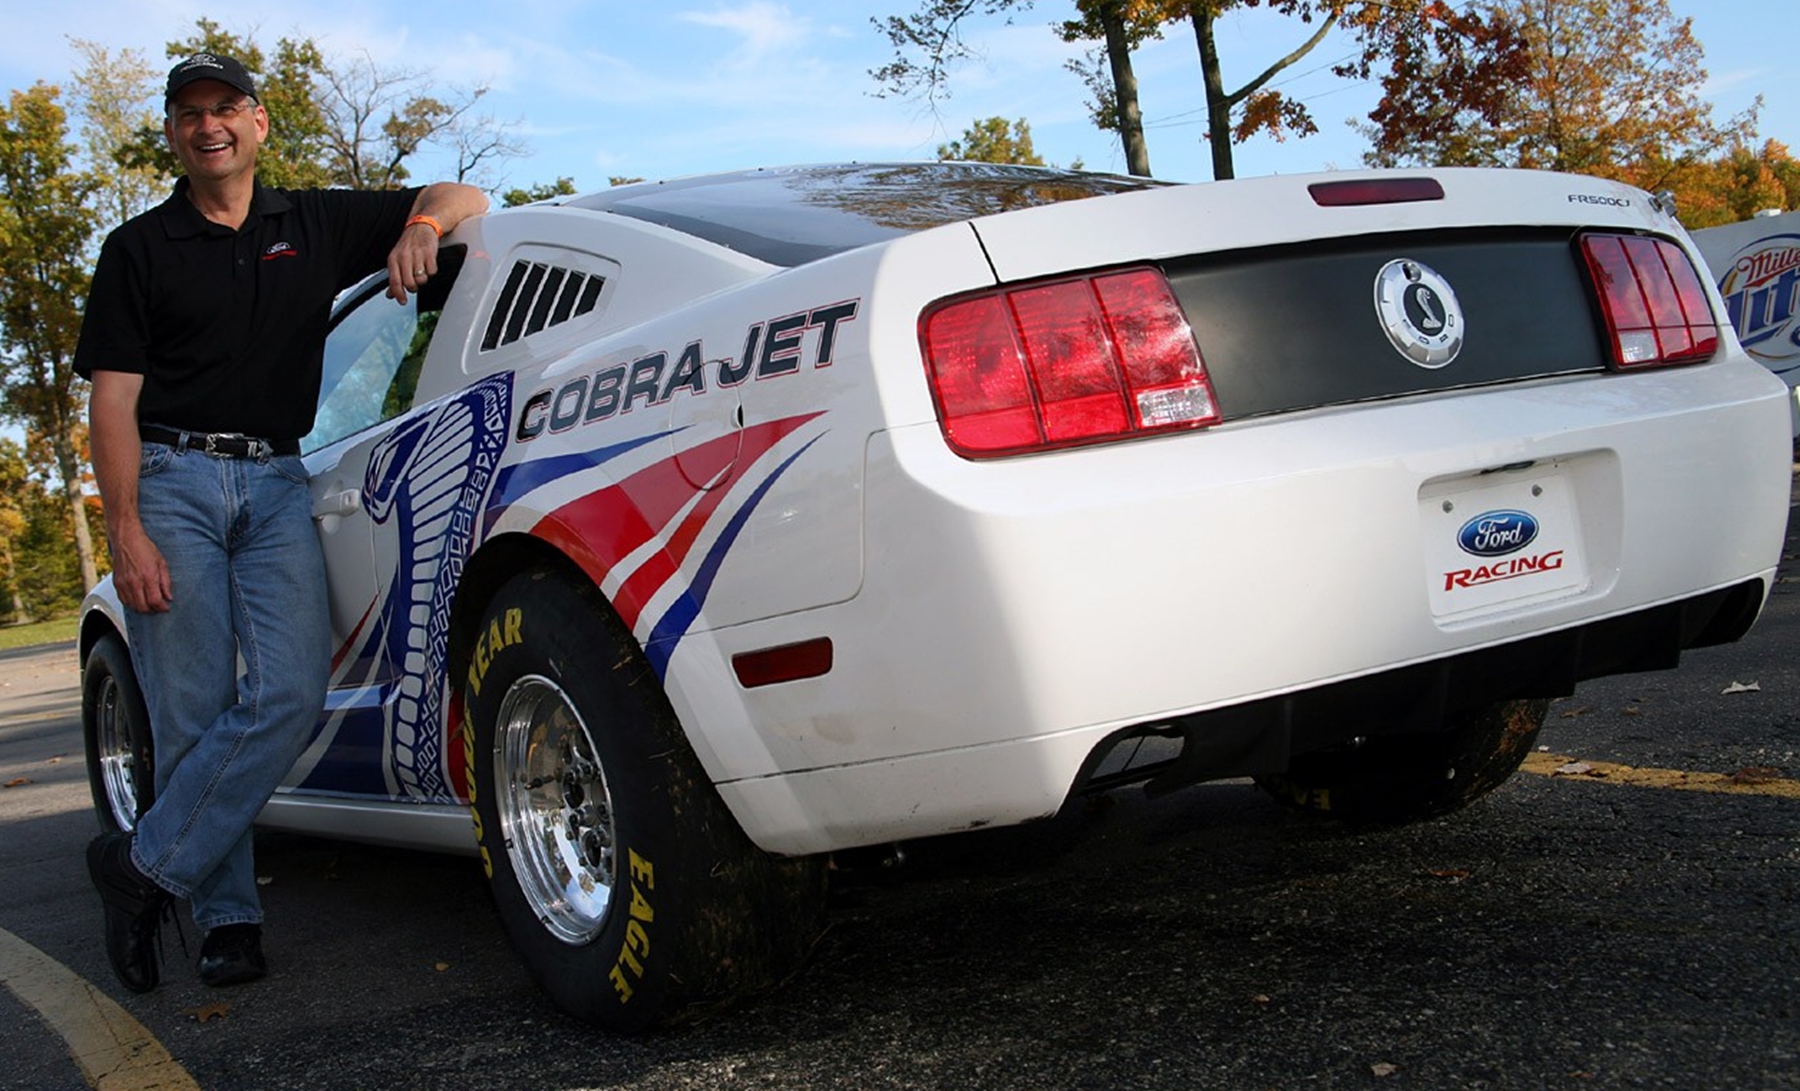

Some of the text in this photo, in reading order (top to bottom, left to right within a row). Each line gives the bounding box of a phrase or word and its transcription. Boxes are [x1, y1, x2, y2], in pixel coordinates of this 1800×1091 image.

[515, 298, 861, 443] COBRA JET
[1443, 550, 1564, 591] RACING
[1474, 516, 1524, 550] Ford
[609, 846, 655, 1004] EAGLE
